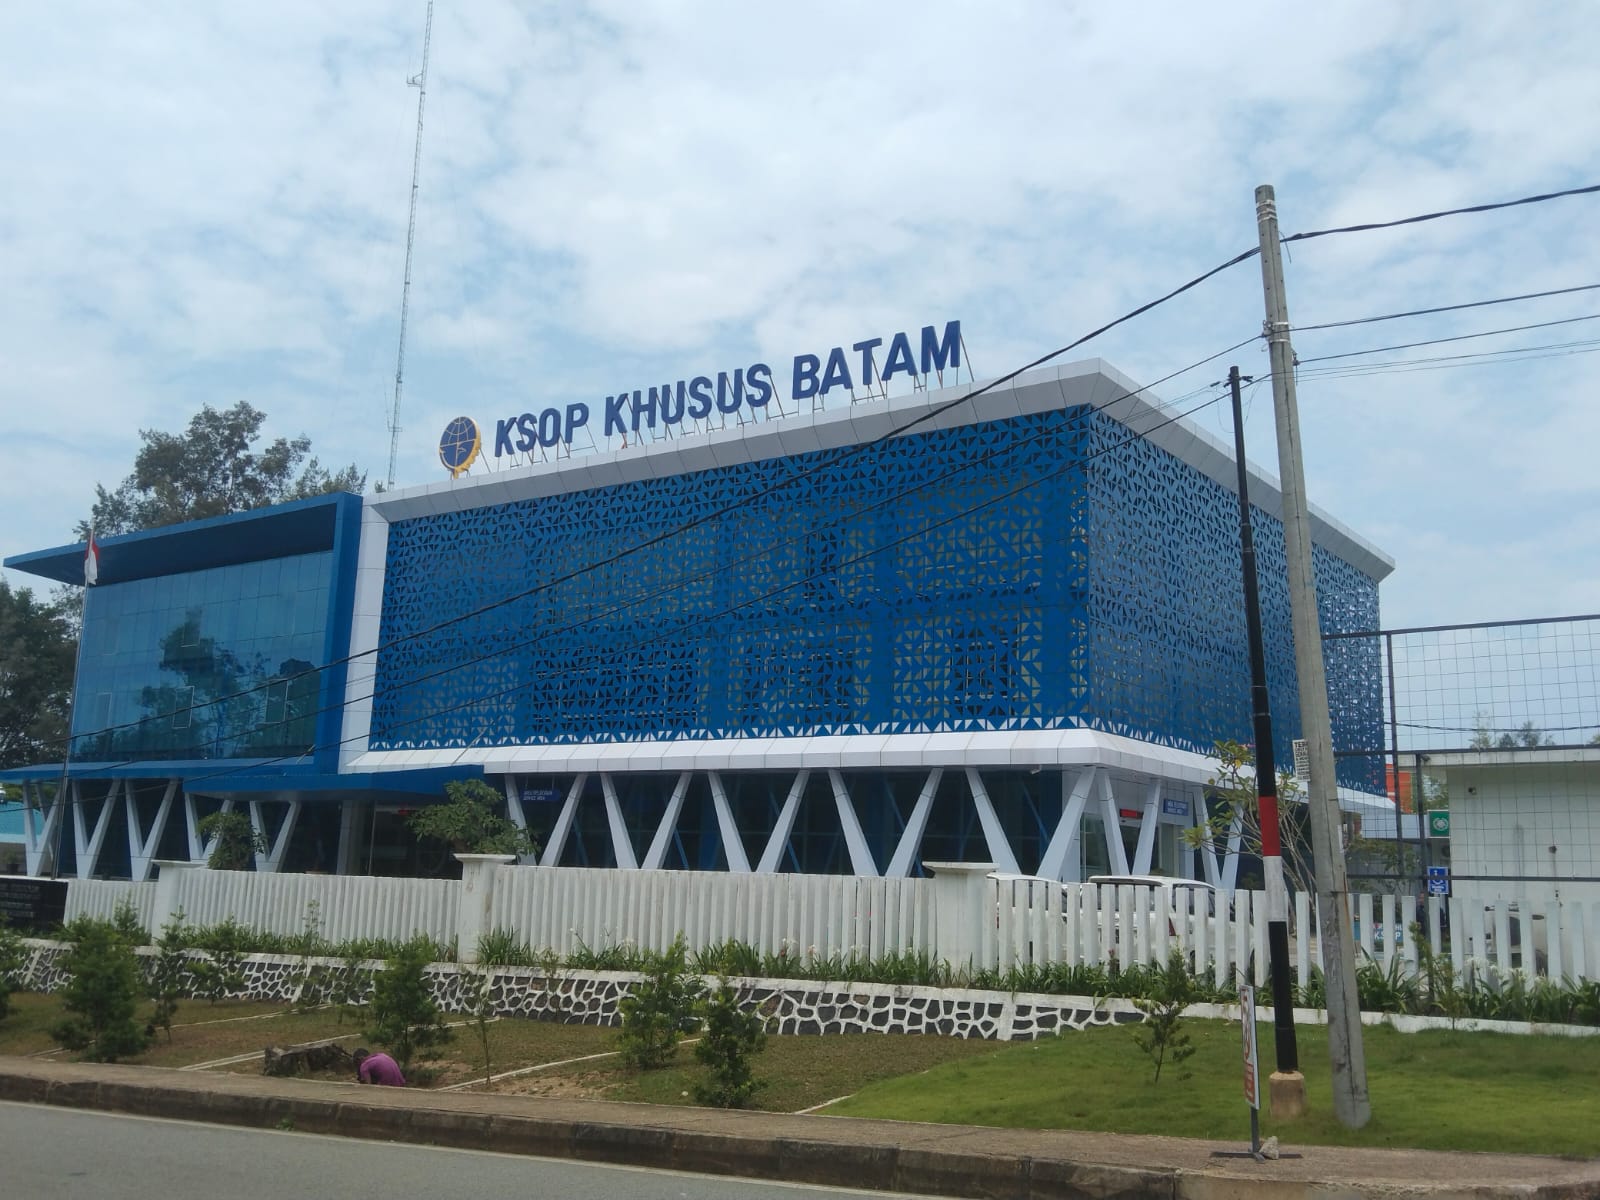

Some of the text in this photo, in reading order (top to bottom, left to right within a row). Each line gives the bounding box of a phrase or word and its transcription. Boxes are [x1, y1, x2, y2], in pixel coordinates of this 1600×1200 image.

[495, 320, 960, 457] KSOP KHUSUS BATAM
